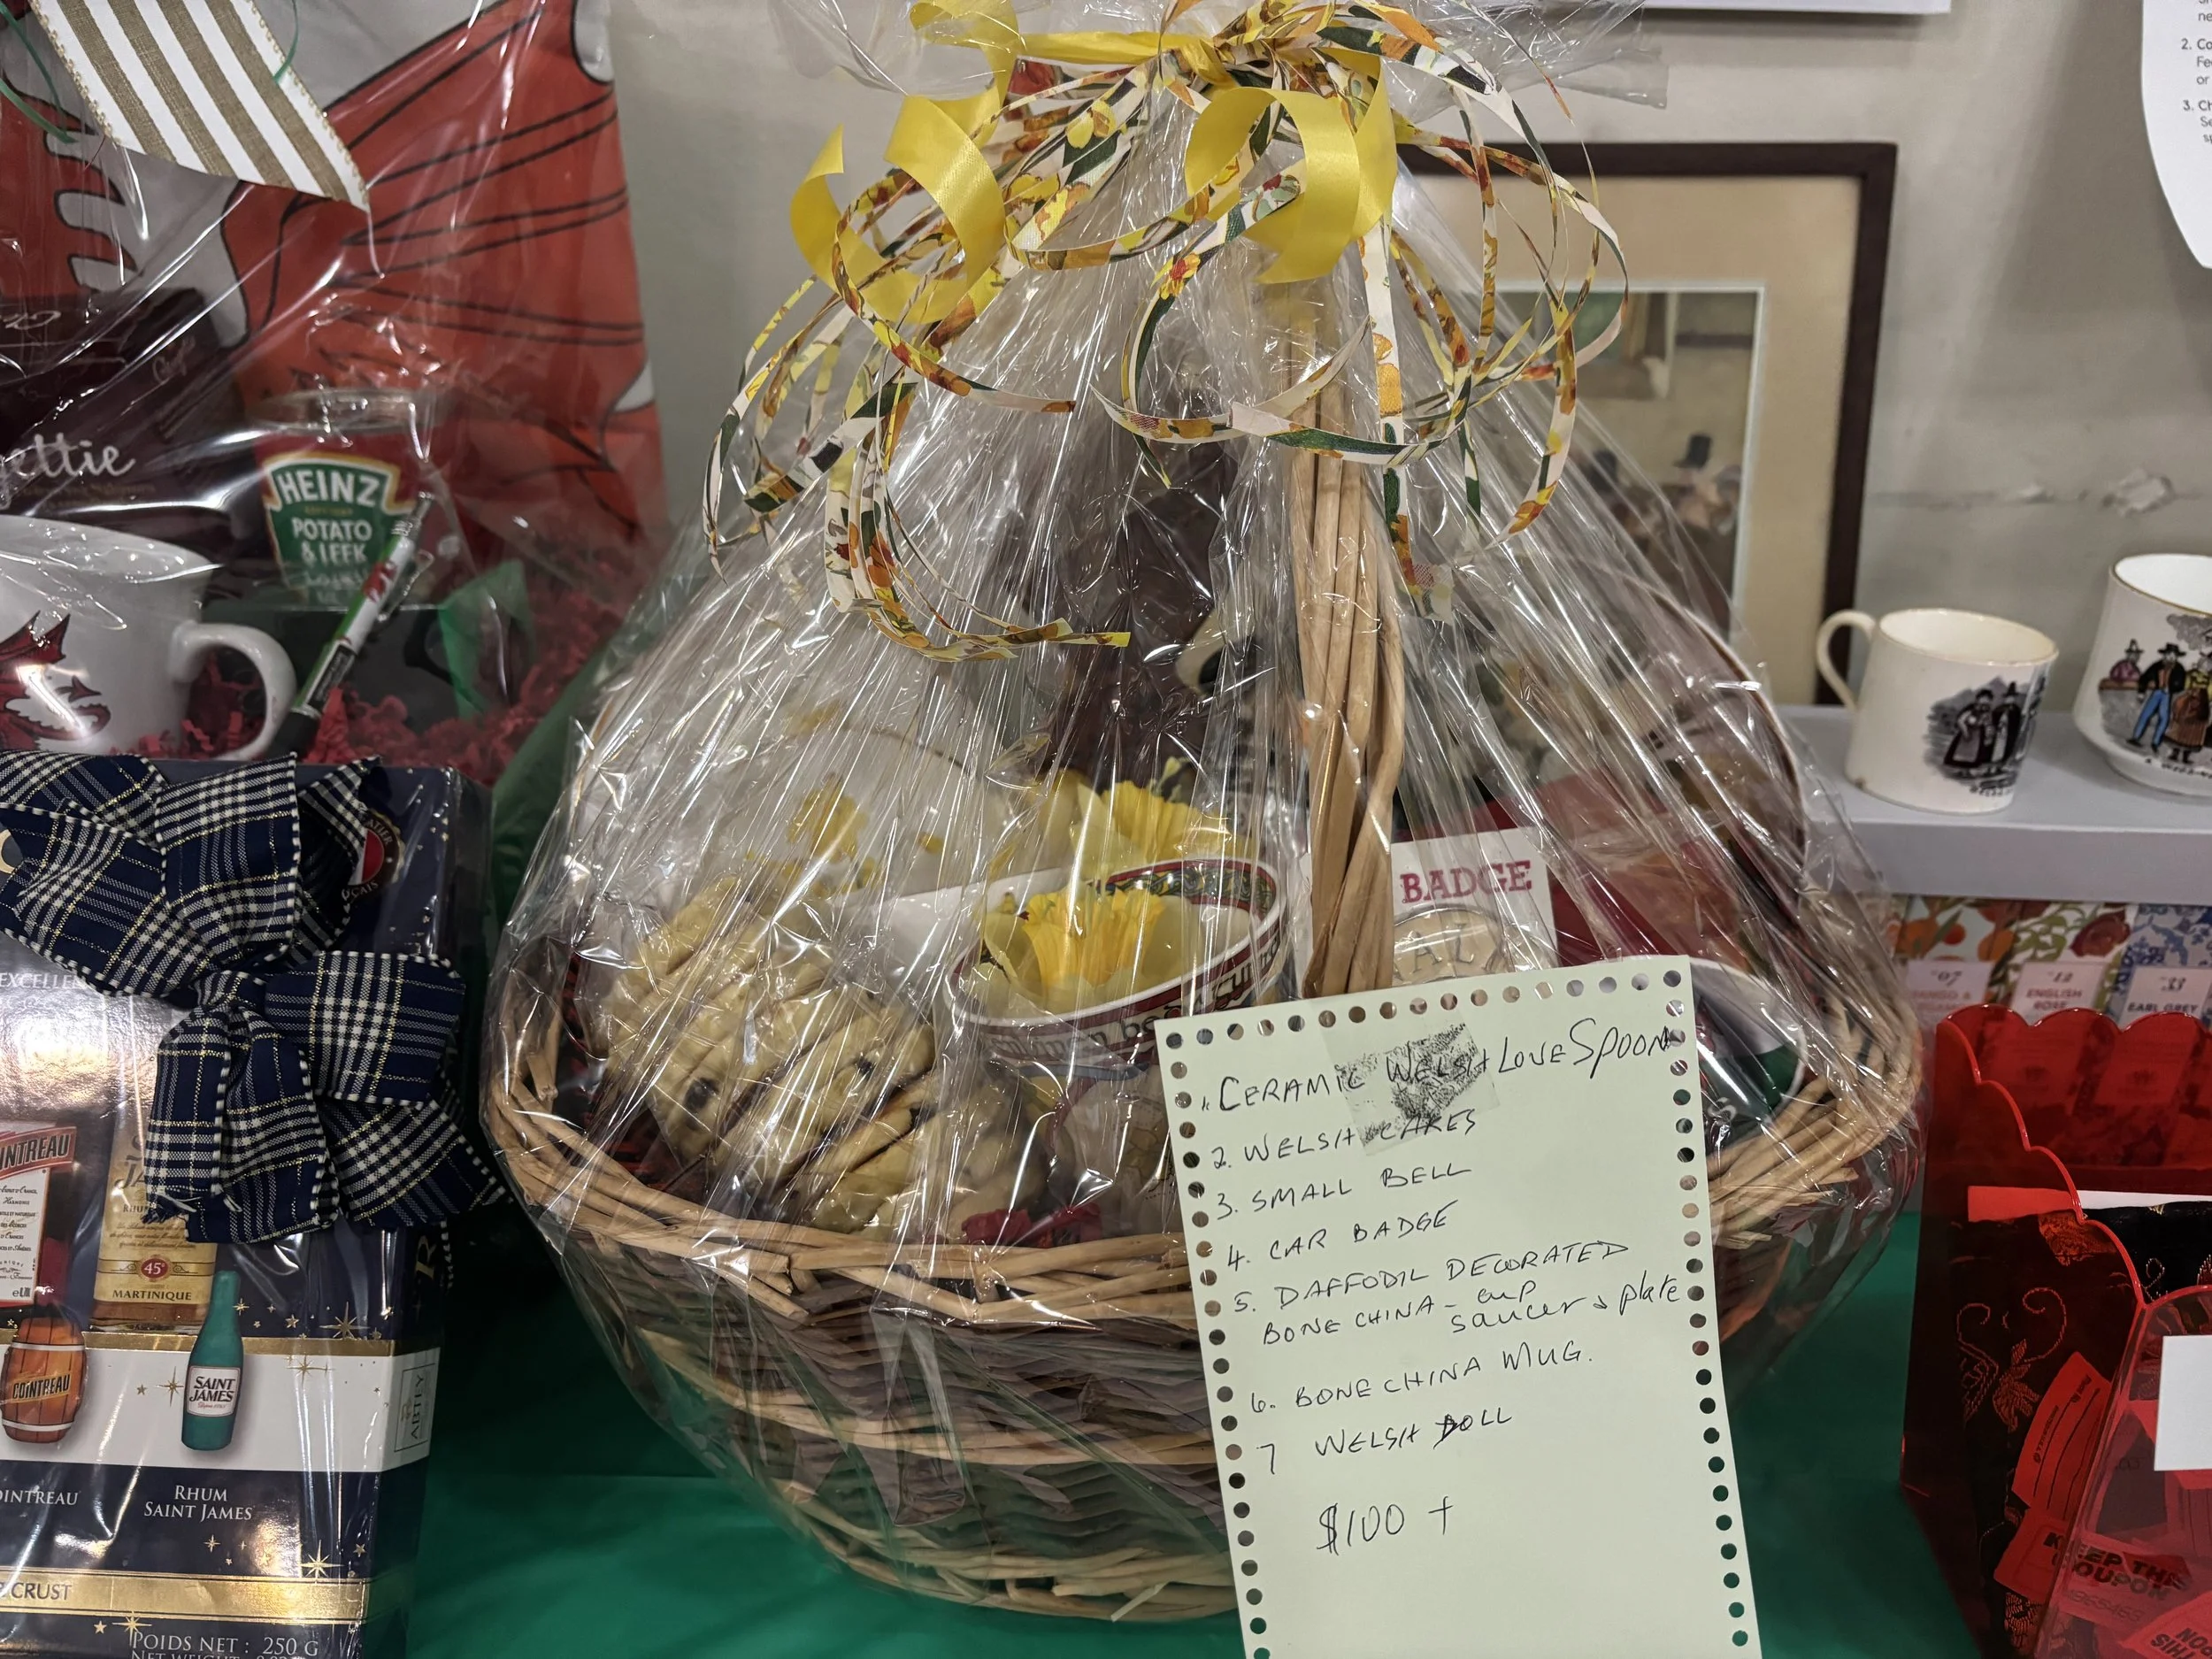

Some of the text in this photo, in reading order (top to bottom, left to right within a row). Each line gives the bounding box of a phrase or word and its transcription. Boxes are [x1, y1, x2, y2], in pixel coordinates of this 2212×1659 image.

[2181, 38, 2193, 50] 2.
[2196, 74, 2209, 86] or
[2183, 99, 2194, 111] 3.
[276, 469, 380, 507] HEINZ
[291, 517, 373, 541] POTATO
[300, 542, 316, 568] &
[1400, 859, 1532, 903] BADGE
[2127, 1002, 2158, 1013] EARL
[1219, 1069, 1367, 1112] CERAMIC
[1385, 1048, 1492, 1085] WELSH
[1210, 1108, 1477, 1171] 2. WELSH CAKES
[1216, 1162, 1472, 1221] 3. SMALL BELL
[122, 1204, 147, 1213] RHU
[1227, 1199, 1460, 1271] 4. CAR BADGE
[1233, 1240, 1631, 1314] 5. DAFFODIL DECORATED
[112, 1289, 192, 1301] MARTINIQUE
[1450, 1294, 1588, 1333] saucer
[1618, 1269, 1683, 1317] plate
[1263, 1317, 1342, 1347] BONE
[1355, 1294, 1437, 1330] CHINA
[1477, 1279, 1538, 1312] cup
[12, 1373, 71, 1399] COINTREAU
[188, 1389, 235, 1402] JAMES
[194, 1375, 236, 1390] SAINT
[1251, 1389, 1277, 1414] 6.
[1294, 1378, 1372, 1409] BONE
[1383, 1356, 1483, 1395] CHINA
[1255, 1407, 1514, 1476] 7 WELSH DOLL
[174, 1485, 228, 1502] RHUM
[143, 1502, 253, 1523] SAINT JAMES
[1316, 1502, 1407, 1557] $100
[11, 1580, 73, 1601] CRUST
[132, 1632, 192, 1651] POIDS
[199, 1637, 239, 1654] NET
[262, 1637, 297, 1655] 250
[303, 1640, 319, 1657] G
